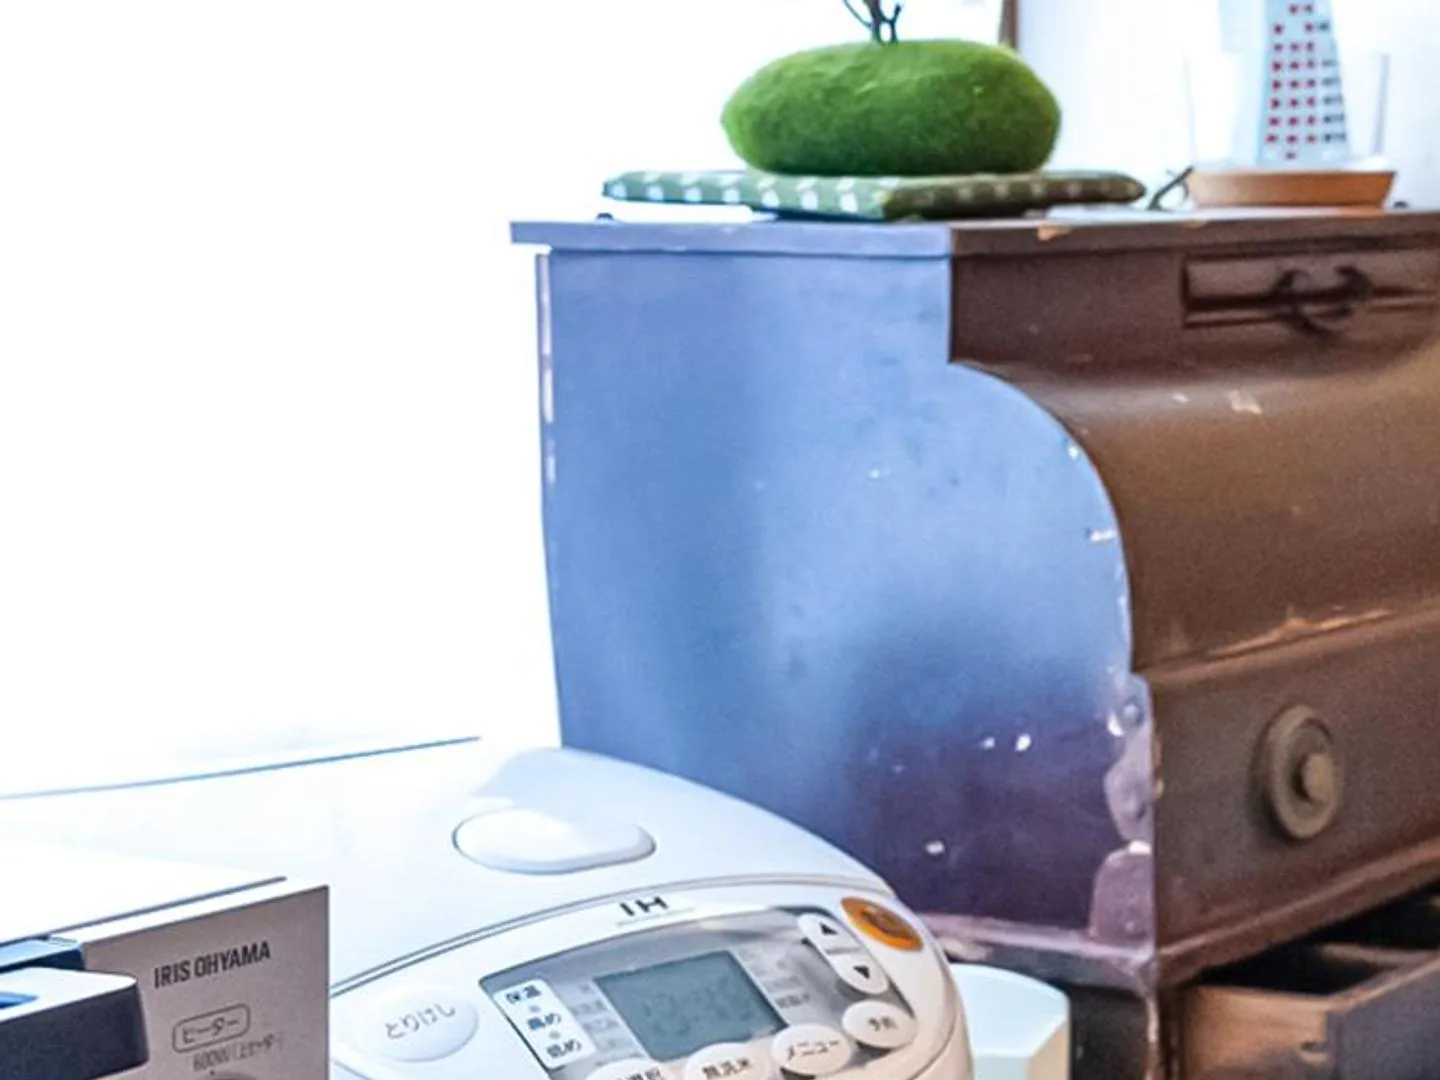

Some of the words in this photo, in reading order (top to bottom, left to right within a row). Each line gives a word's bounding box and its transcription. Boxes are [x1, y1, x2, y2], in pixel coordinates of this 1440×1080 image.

[154, 960, 191, 989] IRIS
[194, 941, 271, 978] OHYAMA
[182, 1017, 240, 1044] ヒーター
[385, 1003, 456, 1039] とりけし
